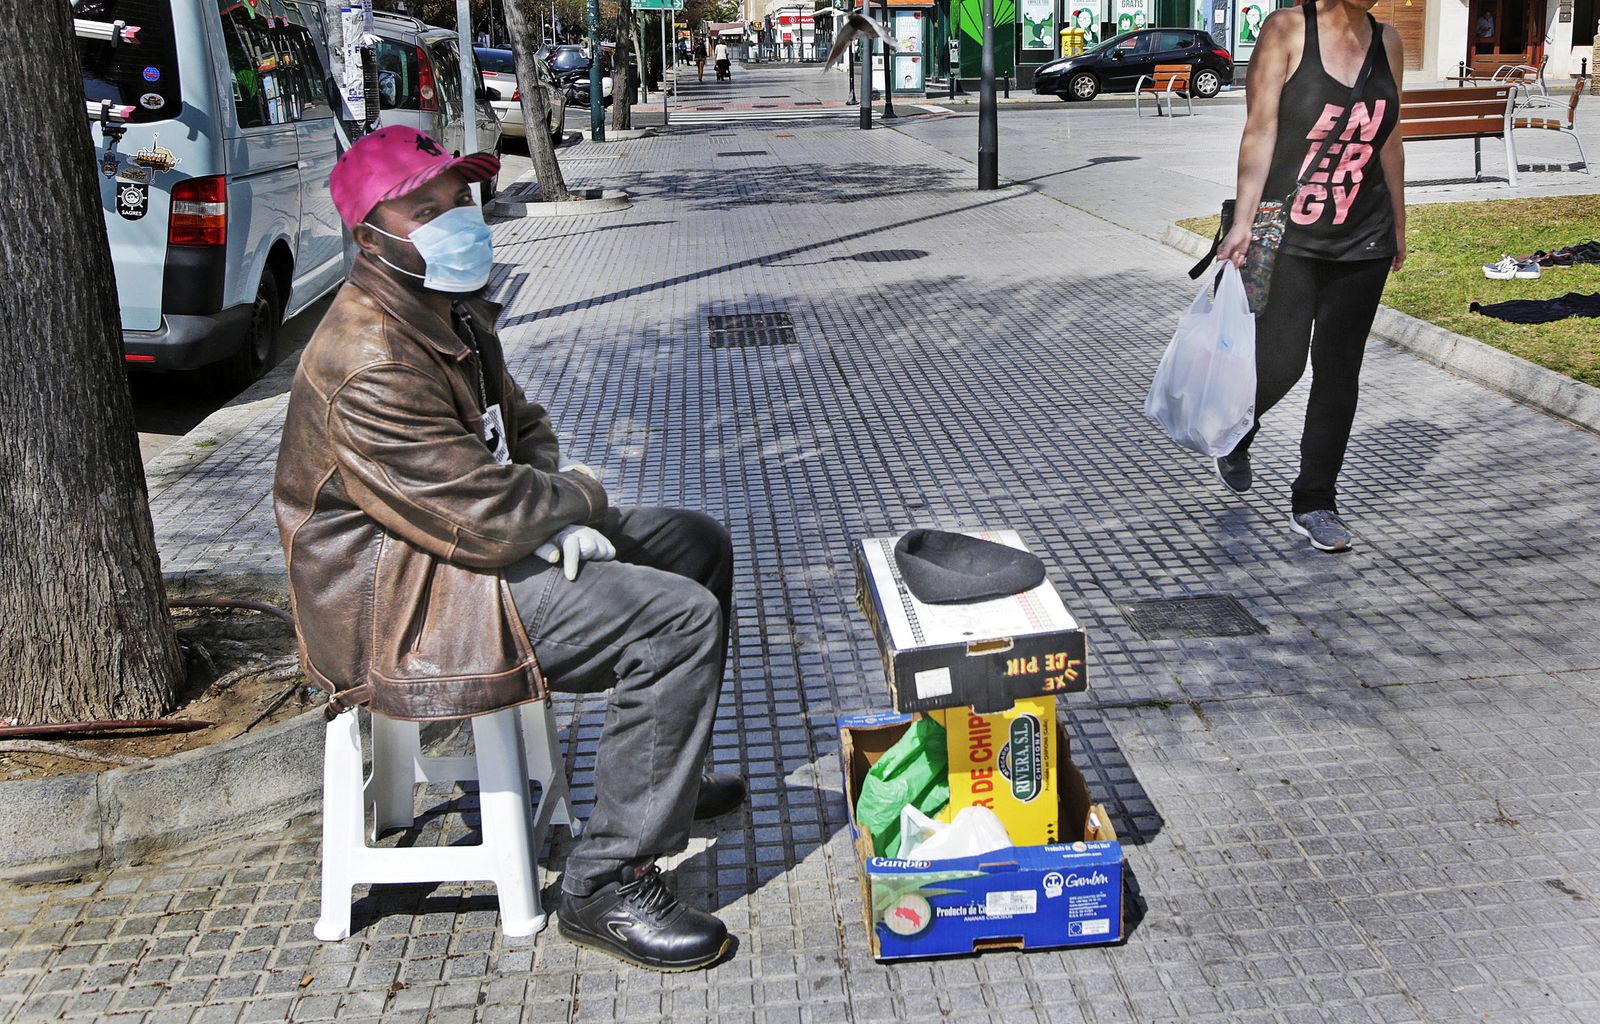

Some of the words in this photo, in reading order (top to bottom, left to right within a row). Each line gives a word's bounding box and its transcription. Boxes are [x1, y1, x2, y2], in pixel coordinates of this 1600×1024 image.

[1121, 0, 1144, 8] GRATIS
[968, 710, 993, 763] CHIP
[1034, 731, 1042, 780] CHIPIONA
[971, 766, 994, 794] DE
[936, 905, 967, 917] Producto
[968, 904, 977, 914] de
